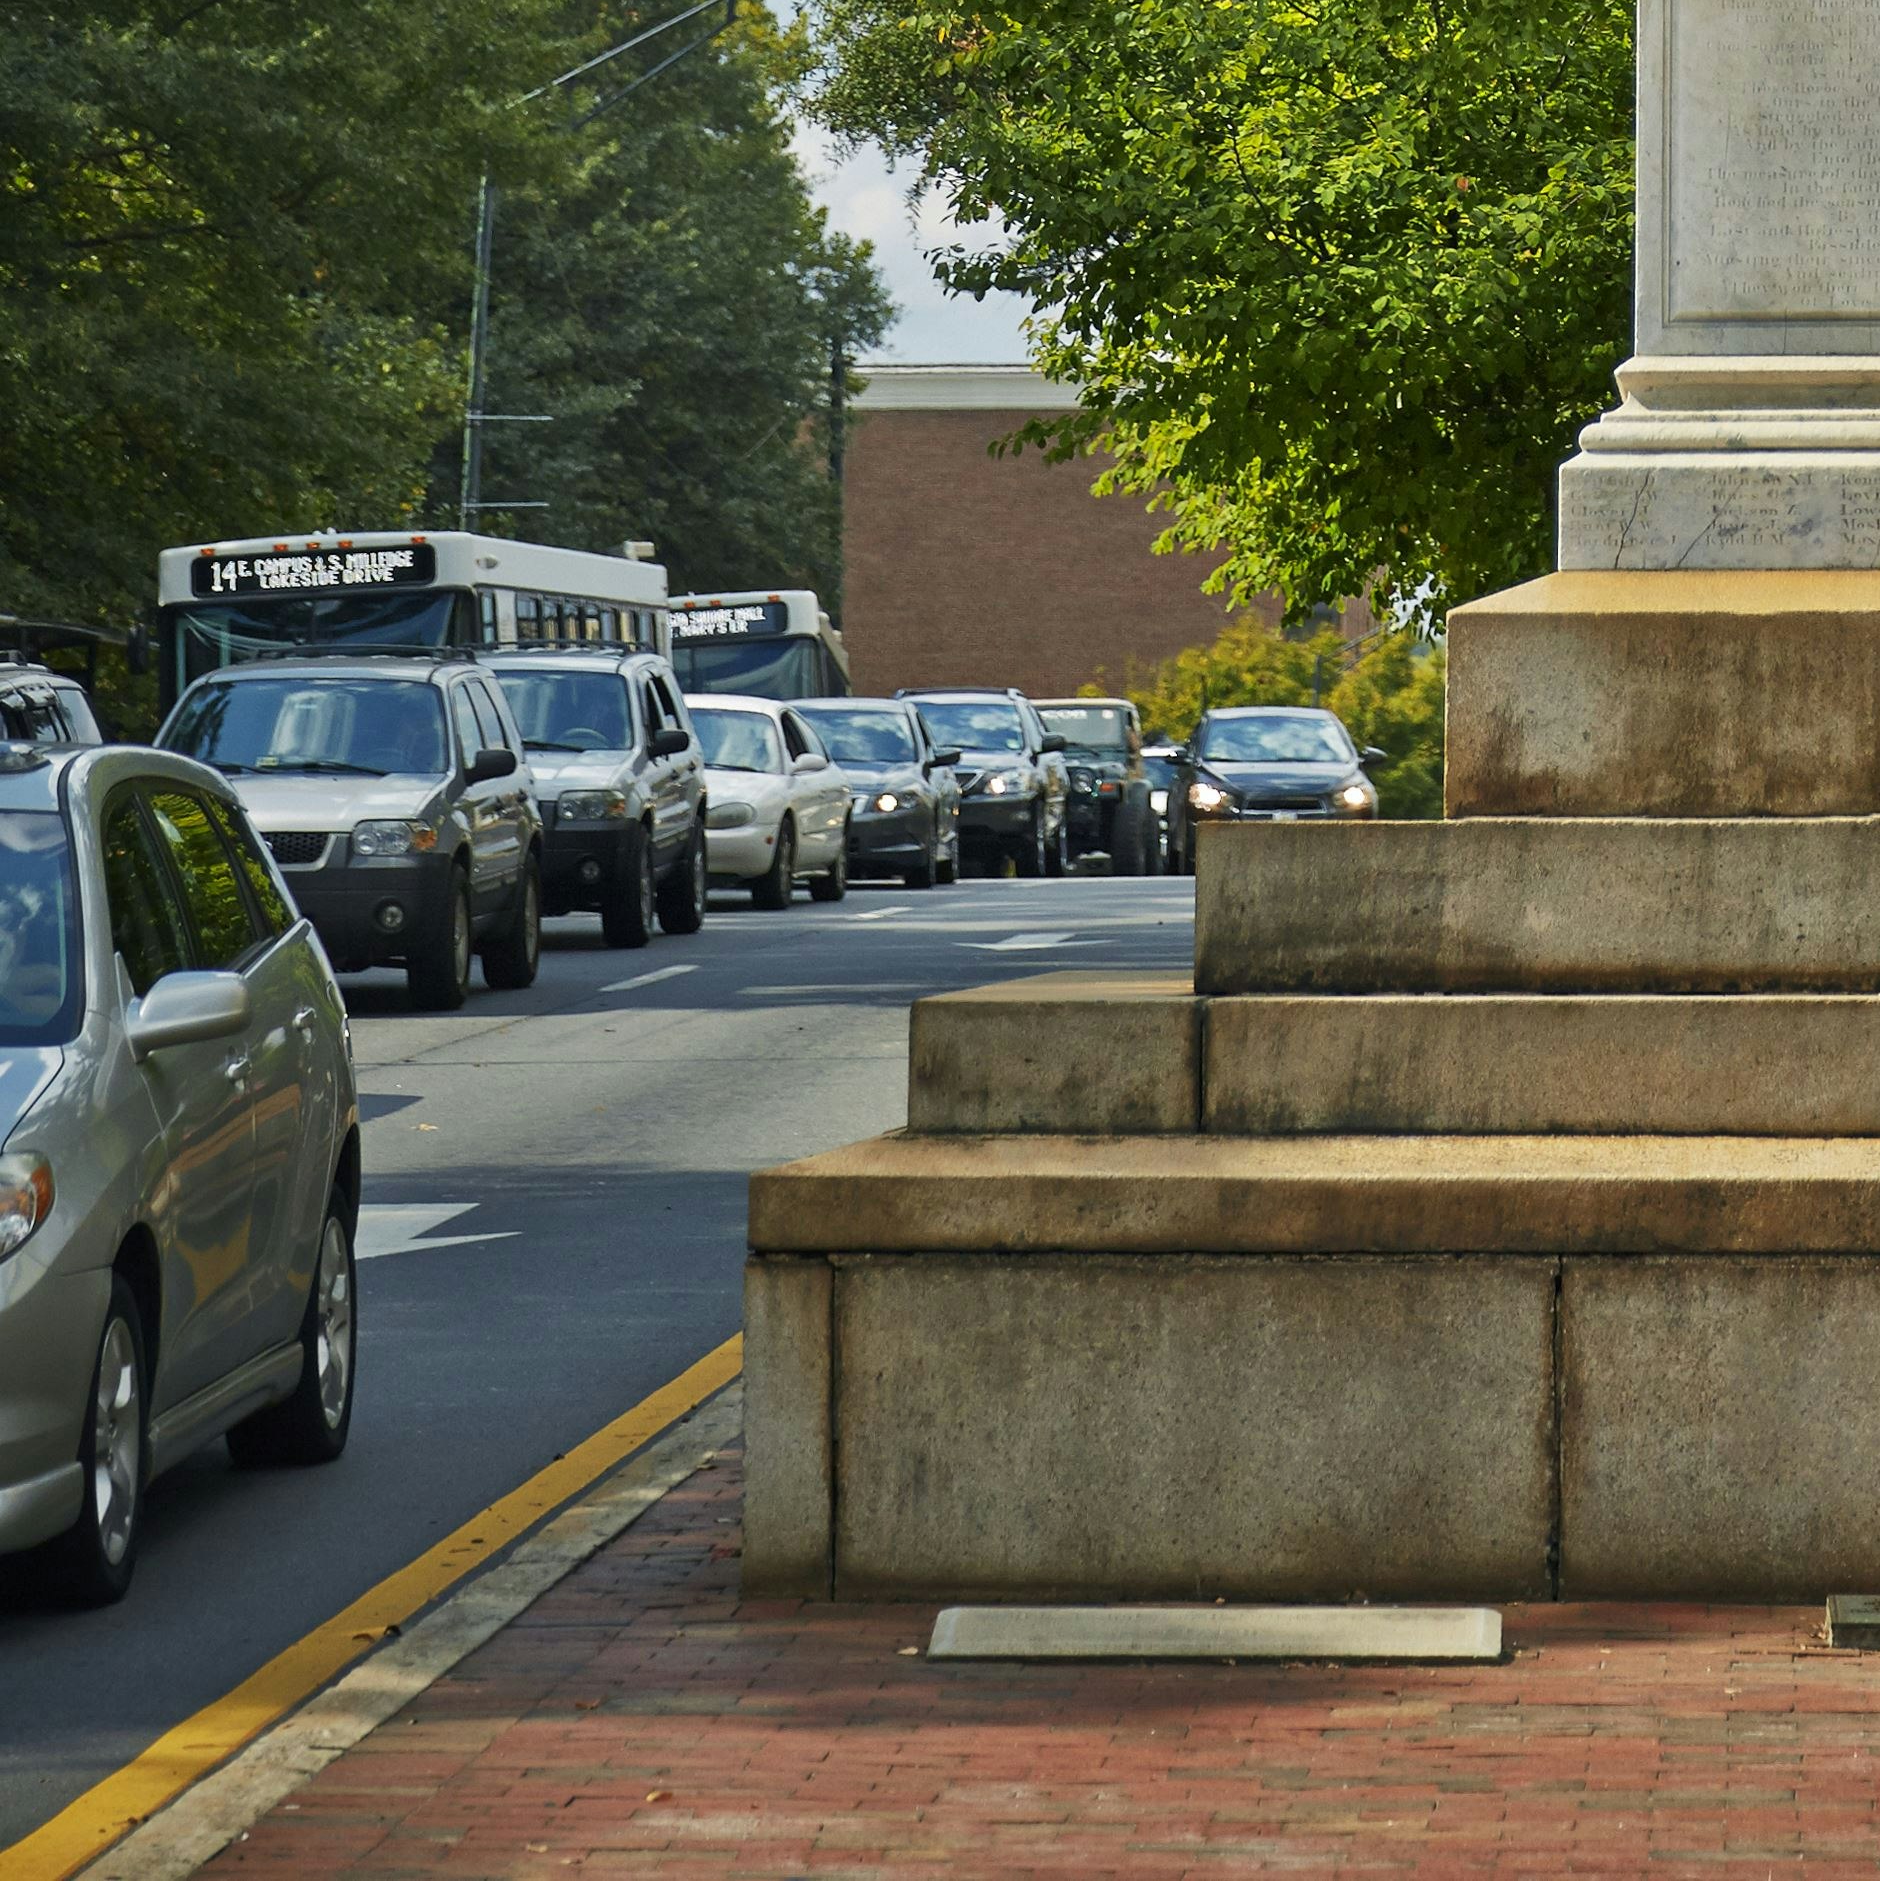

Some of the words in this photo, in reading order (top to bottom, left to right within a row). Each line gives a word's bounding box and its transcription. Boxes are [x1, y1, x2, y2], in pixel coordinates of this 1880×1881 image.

[210, 560, 239, 593] 14
[237, 560, 253, 577] E.
[253, 556, 314, 576] CAMPUS
[328, 554, 344, 570] S.
[345, 550, 415, 569] MILLEDGE
[259, 570, 340, 589] LAKESIDE
[341, 566, 395, 585] DRIVE
